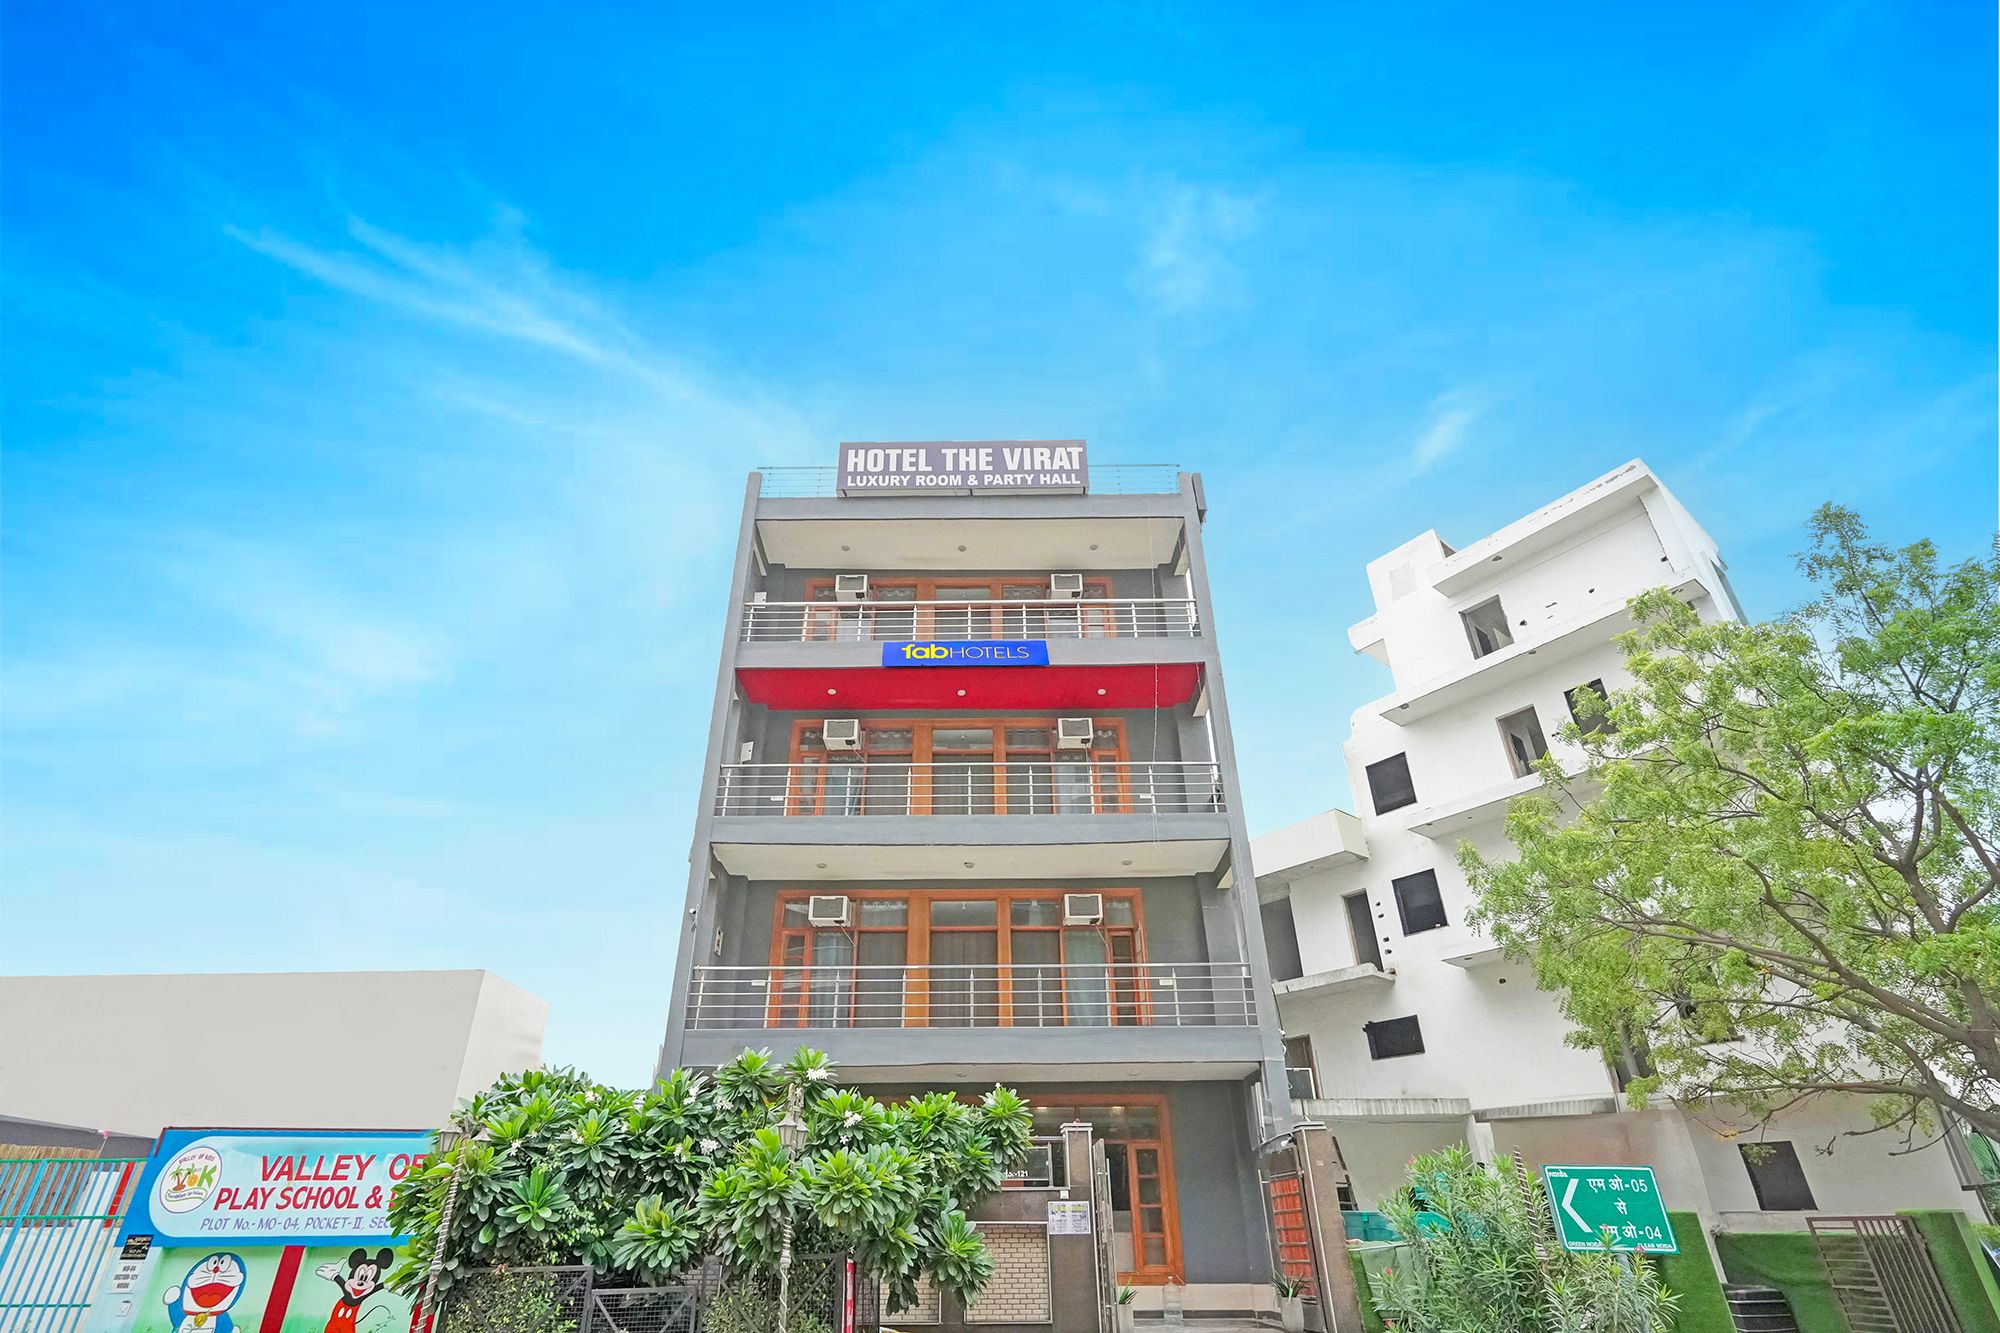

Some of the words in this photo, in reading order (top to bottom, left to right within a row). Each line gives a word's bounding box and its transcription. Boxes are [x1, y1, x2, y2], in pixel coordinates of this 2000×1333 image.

[847, 448, 933, 472] HOTEL
[941, 448, 993, 471] THE
[1002, 447, 1083, 470] VIRAT
[847, 475, 911, 486] LUXURY
[915, 475, 962, 486] ROOM
[967, 474, 979, 486] &
[984, 474, 1034, 485] PARTY
[1040, 474, 1081, 484] HALL
[901, 643, 1030, 660] fabHOTELS
[262, 1154, 376, 1181] VALLEY
[1586, 1179, 1606, 1193] एम
[1608, 1174, 1648, 1193] ओ-05
[213, 1187, 276, 1211] PLAY
[275, 1186, 359, 1210] SCHOOL
[365, 1185, 383, 1209] &
[1614, 1197, 1628, 1215] से
[200, 1217, 230, 1231] PLOT
[369, 1215, 389, 1229] SEC
[1622, 1220, 1662, 1240] ओ-04
